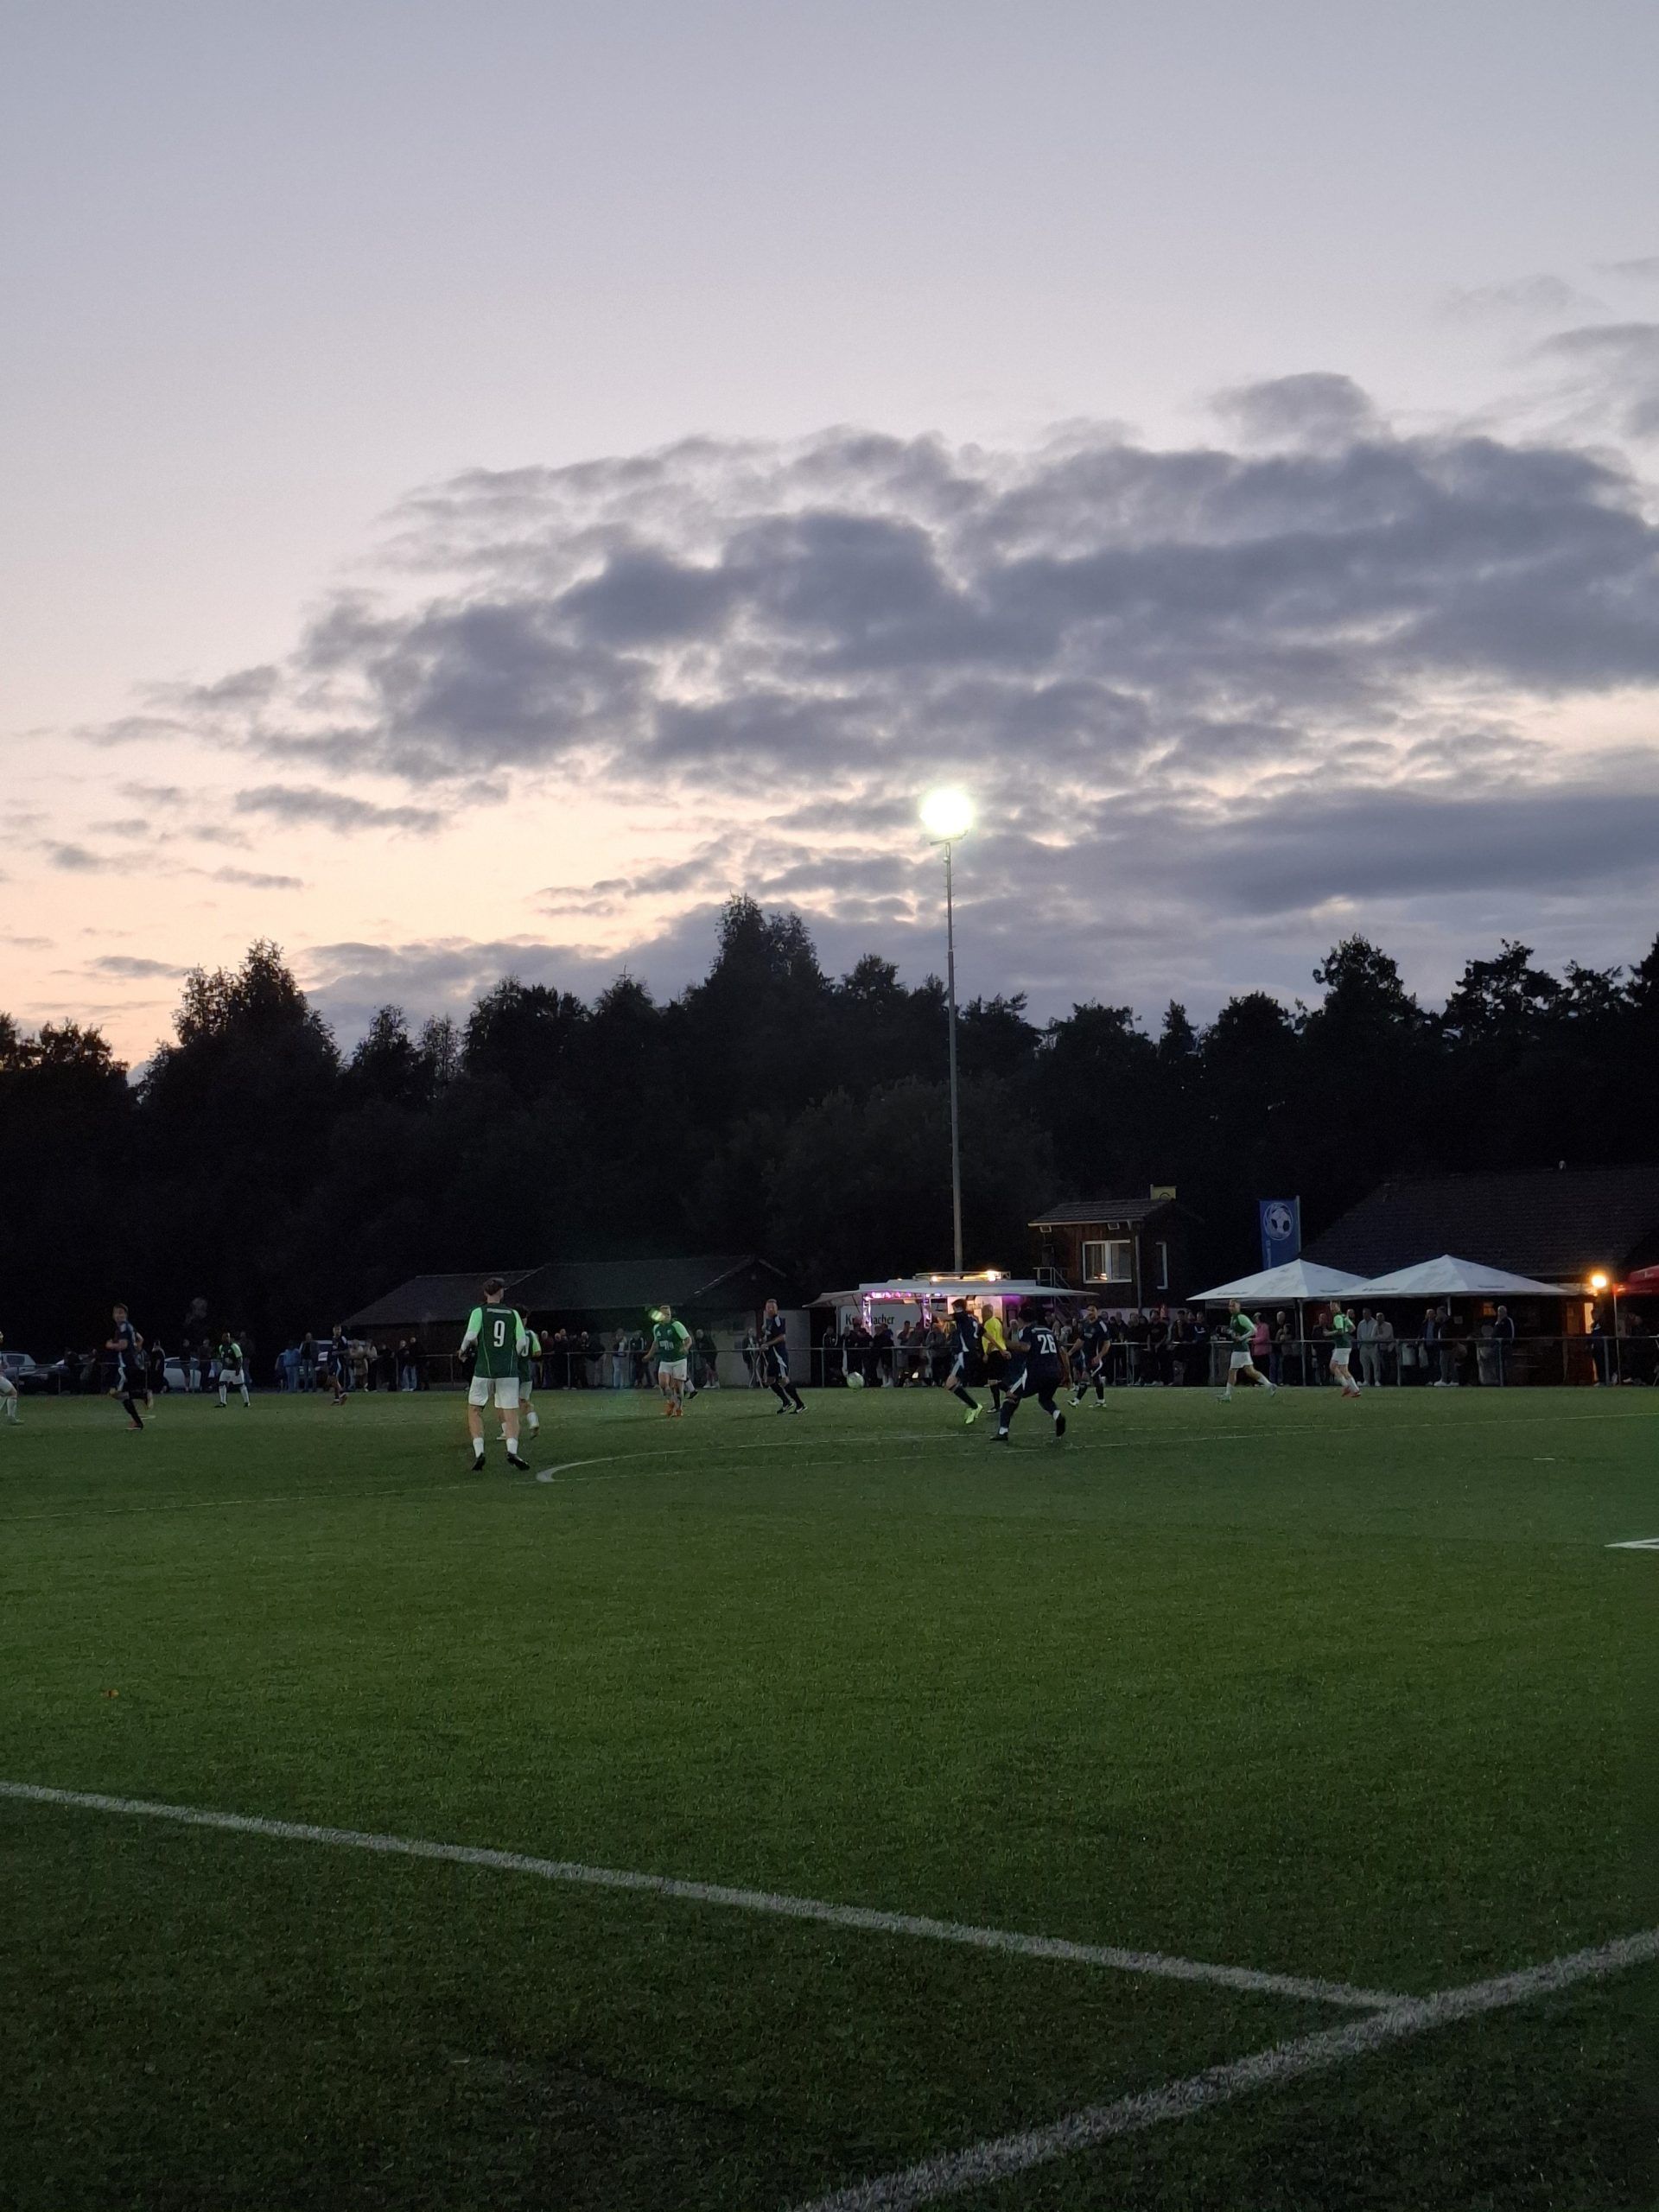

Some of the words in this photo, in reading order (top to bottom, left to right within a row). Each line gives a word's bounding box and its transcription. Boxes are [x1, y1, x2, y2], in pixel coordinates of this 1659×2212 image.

[845, 1313, 894, 1325] Kacher
[493, 1320, 505, 1347] 9
[1037, 1333, 1058, 1355] 26
